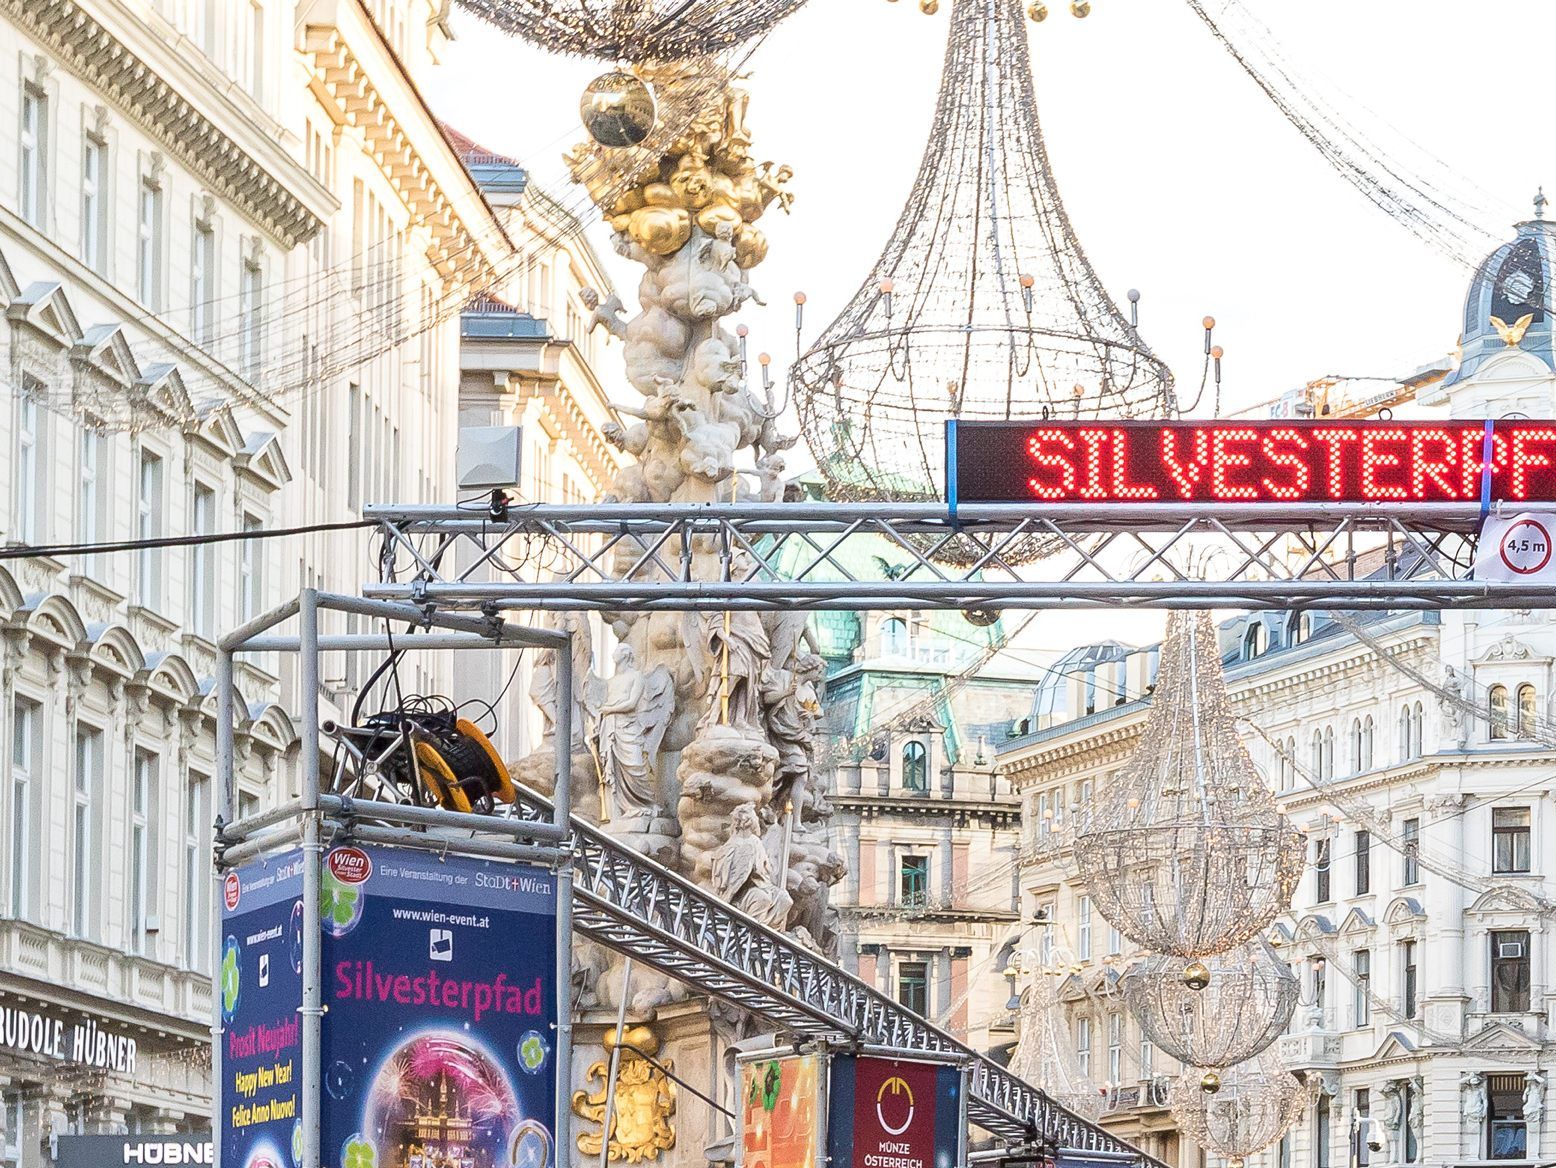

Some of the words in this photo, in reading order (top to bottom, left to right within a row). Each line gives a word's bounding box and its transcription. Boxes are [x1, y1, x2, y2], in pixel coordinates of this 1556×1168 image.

[1507, 539, 1530, 554] 4,5
[1532, 543, 1546, 552] m
[334, 852, 365, 868] Wien
[380, 864, 398, 877] Eine
[399, 867, 454, 886] Veranstaltung
[454, 874, 469, 885] der
[519, 879, 552, 895] Wien
[392, 908, 490, 929] www.wien-event.at
[336, 960, 543, 1023] Silvesterpfad
[72, 1019, 137, 1074] HÜBNER
[235, 1071, 257, 1098] Happy
[258, 1066, 274, 1089] New
[275, 1058, 293, 1085] Year!
[232, 1104, 251, 1128] Felice
[251, 1102, 270, 1124] Anno
[270, 1093, 296, 1120] Nuovo!
[878, 1140, 911, 1155] MÜNZE
